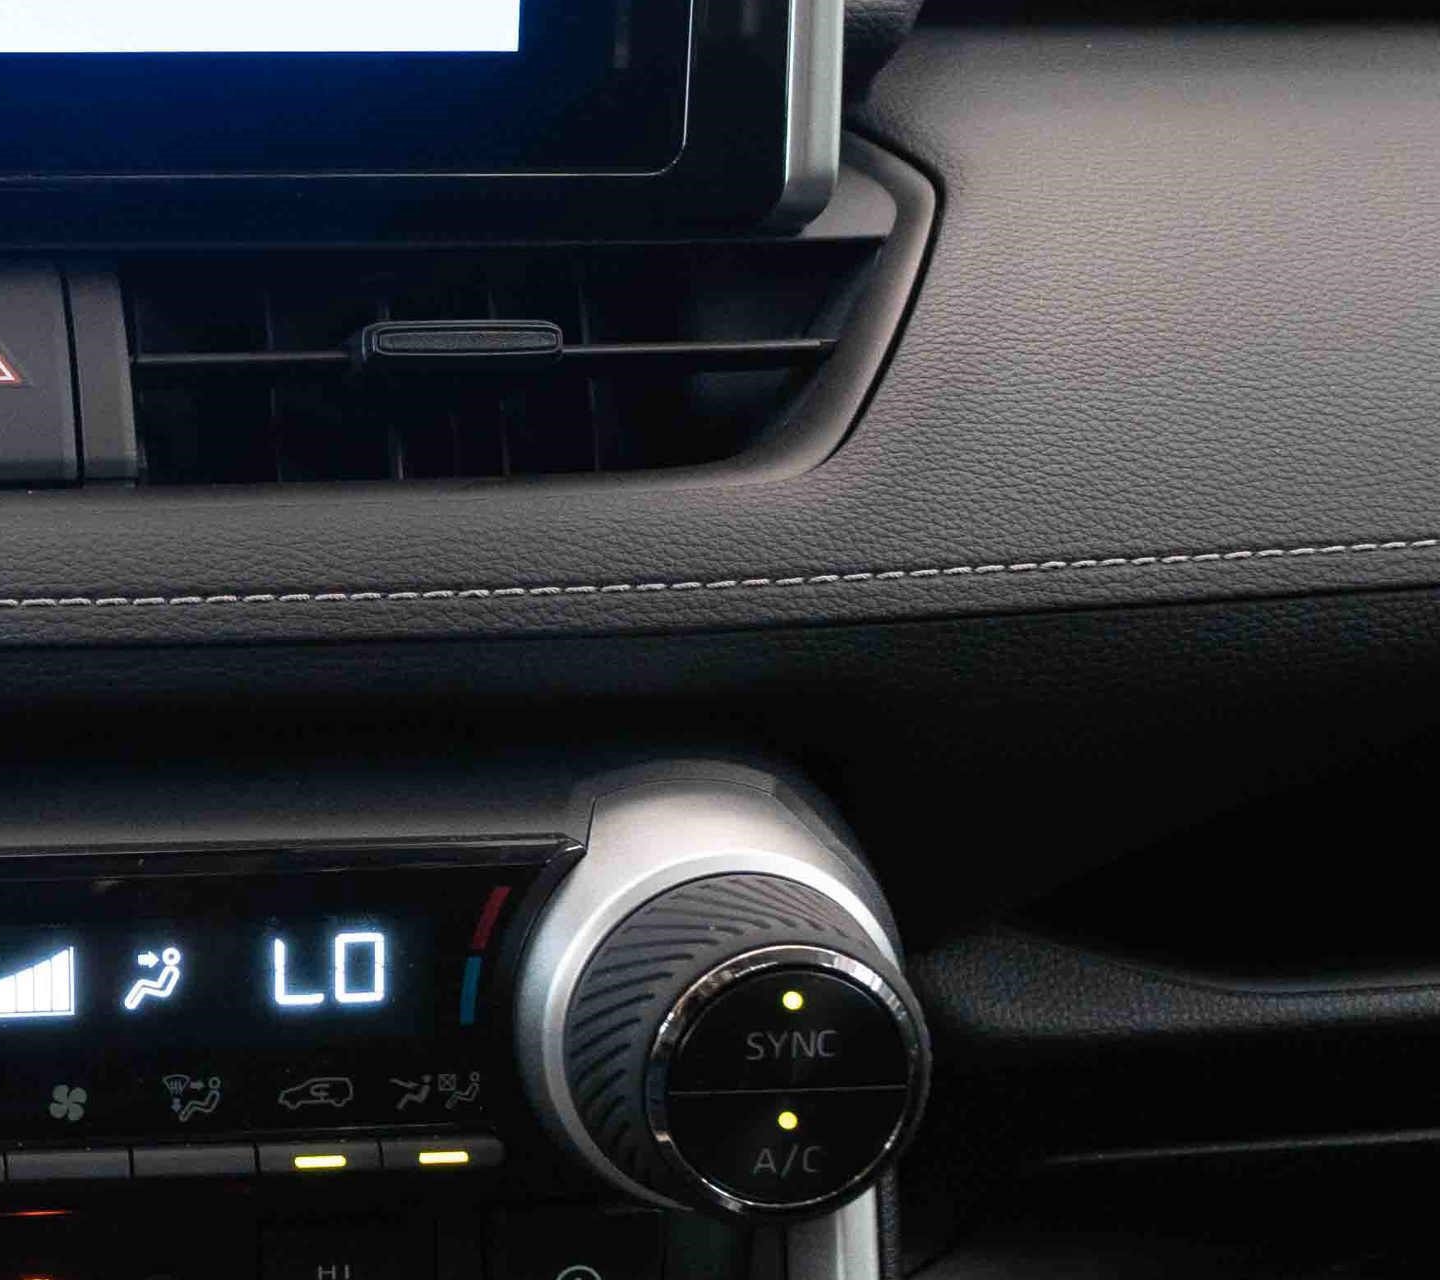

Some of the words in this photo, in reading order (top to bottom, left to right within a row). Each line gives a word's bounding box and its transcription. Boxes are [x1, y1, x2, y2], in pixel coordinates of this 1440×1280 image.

[274, 932, 386, 1006] LO
[744, 1028, 841, 1062] SYNC
[751, 1143, 823, 1176] A/C
[318, 1264, 351, 1280] HI
